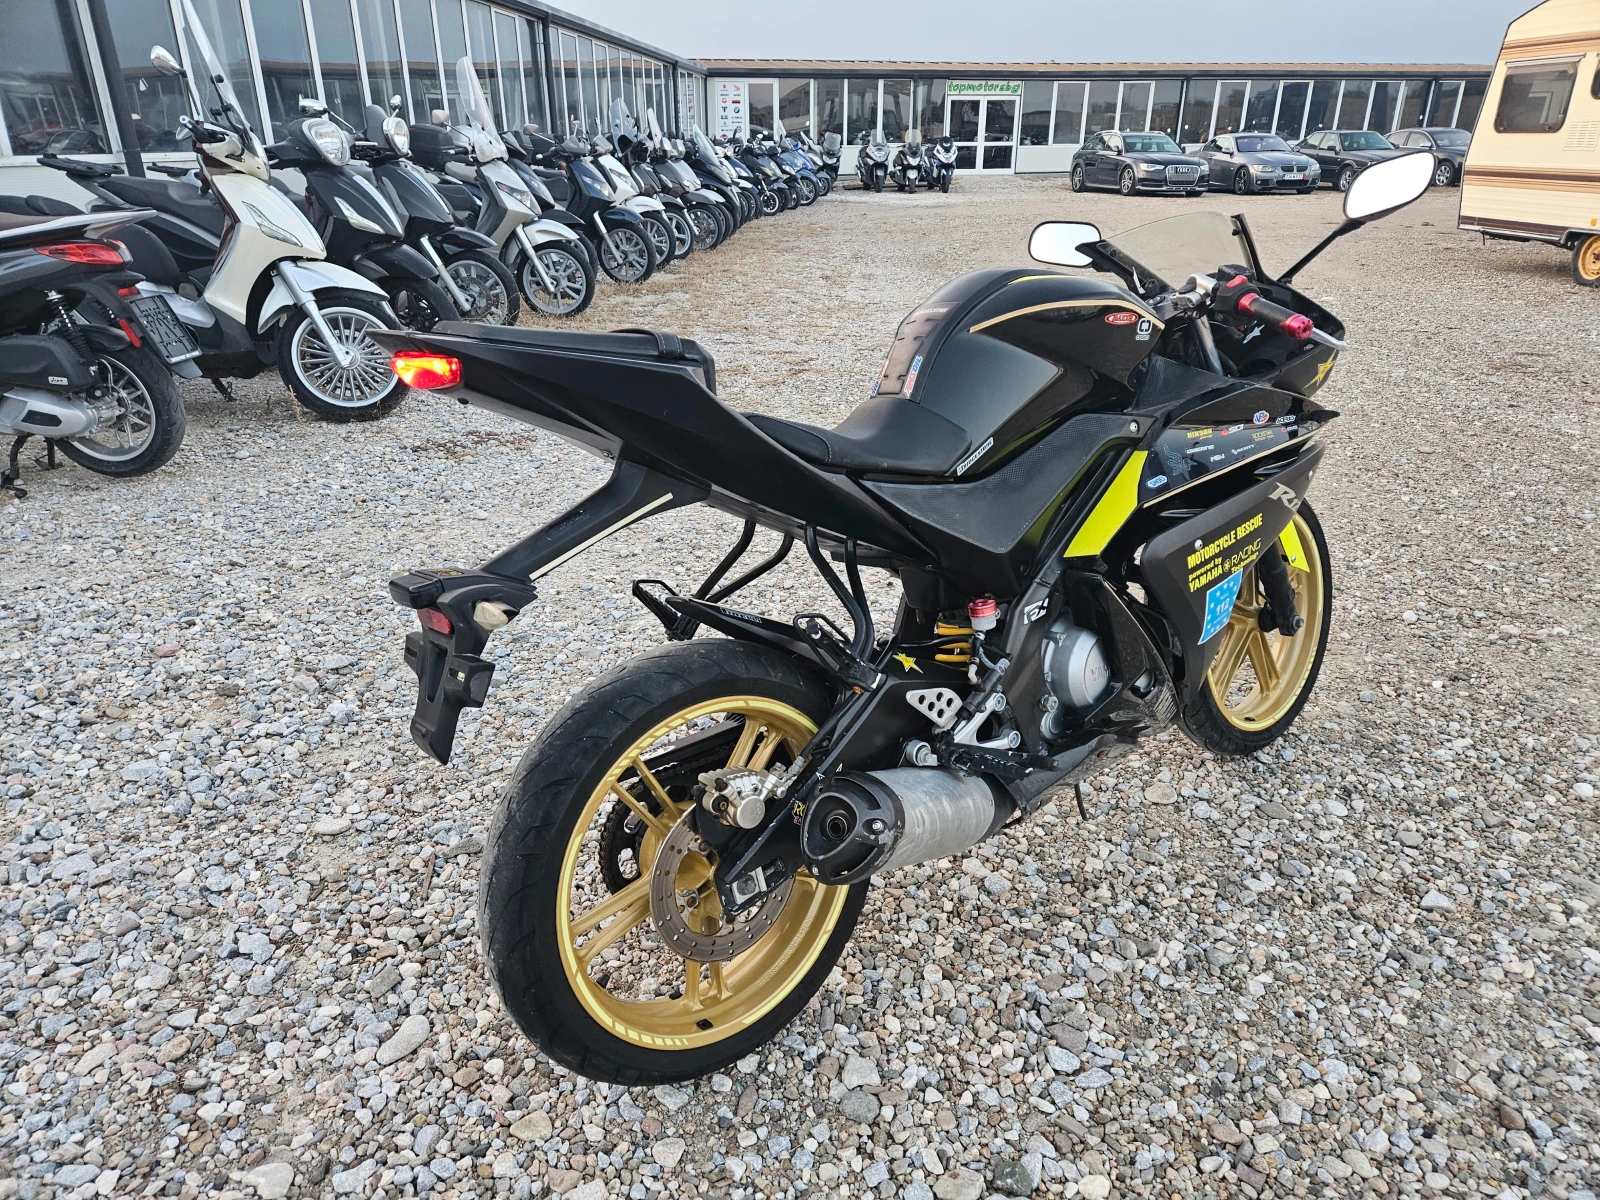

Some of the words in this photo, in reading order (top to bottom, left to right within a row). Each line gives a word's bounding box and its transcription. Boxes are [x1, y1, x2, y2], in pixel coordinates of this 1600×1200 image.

[948, 80, 1020, 94] topmotorsbg
[1187, 530, 1236, 569] MOTORCYCLE
[1236, 513, 1263, 540] RESCUE
[1188, 565, 1223, 593] YAMAHA
[1231, 537, 1262, 567] RACING
[1188, 560, 1215, 582] powered
[1214, 556, 1223, 568] by
[1216, 598, 1230, 616] 112
